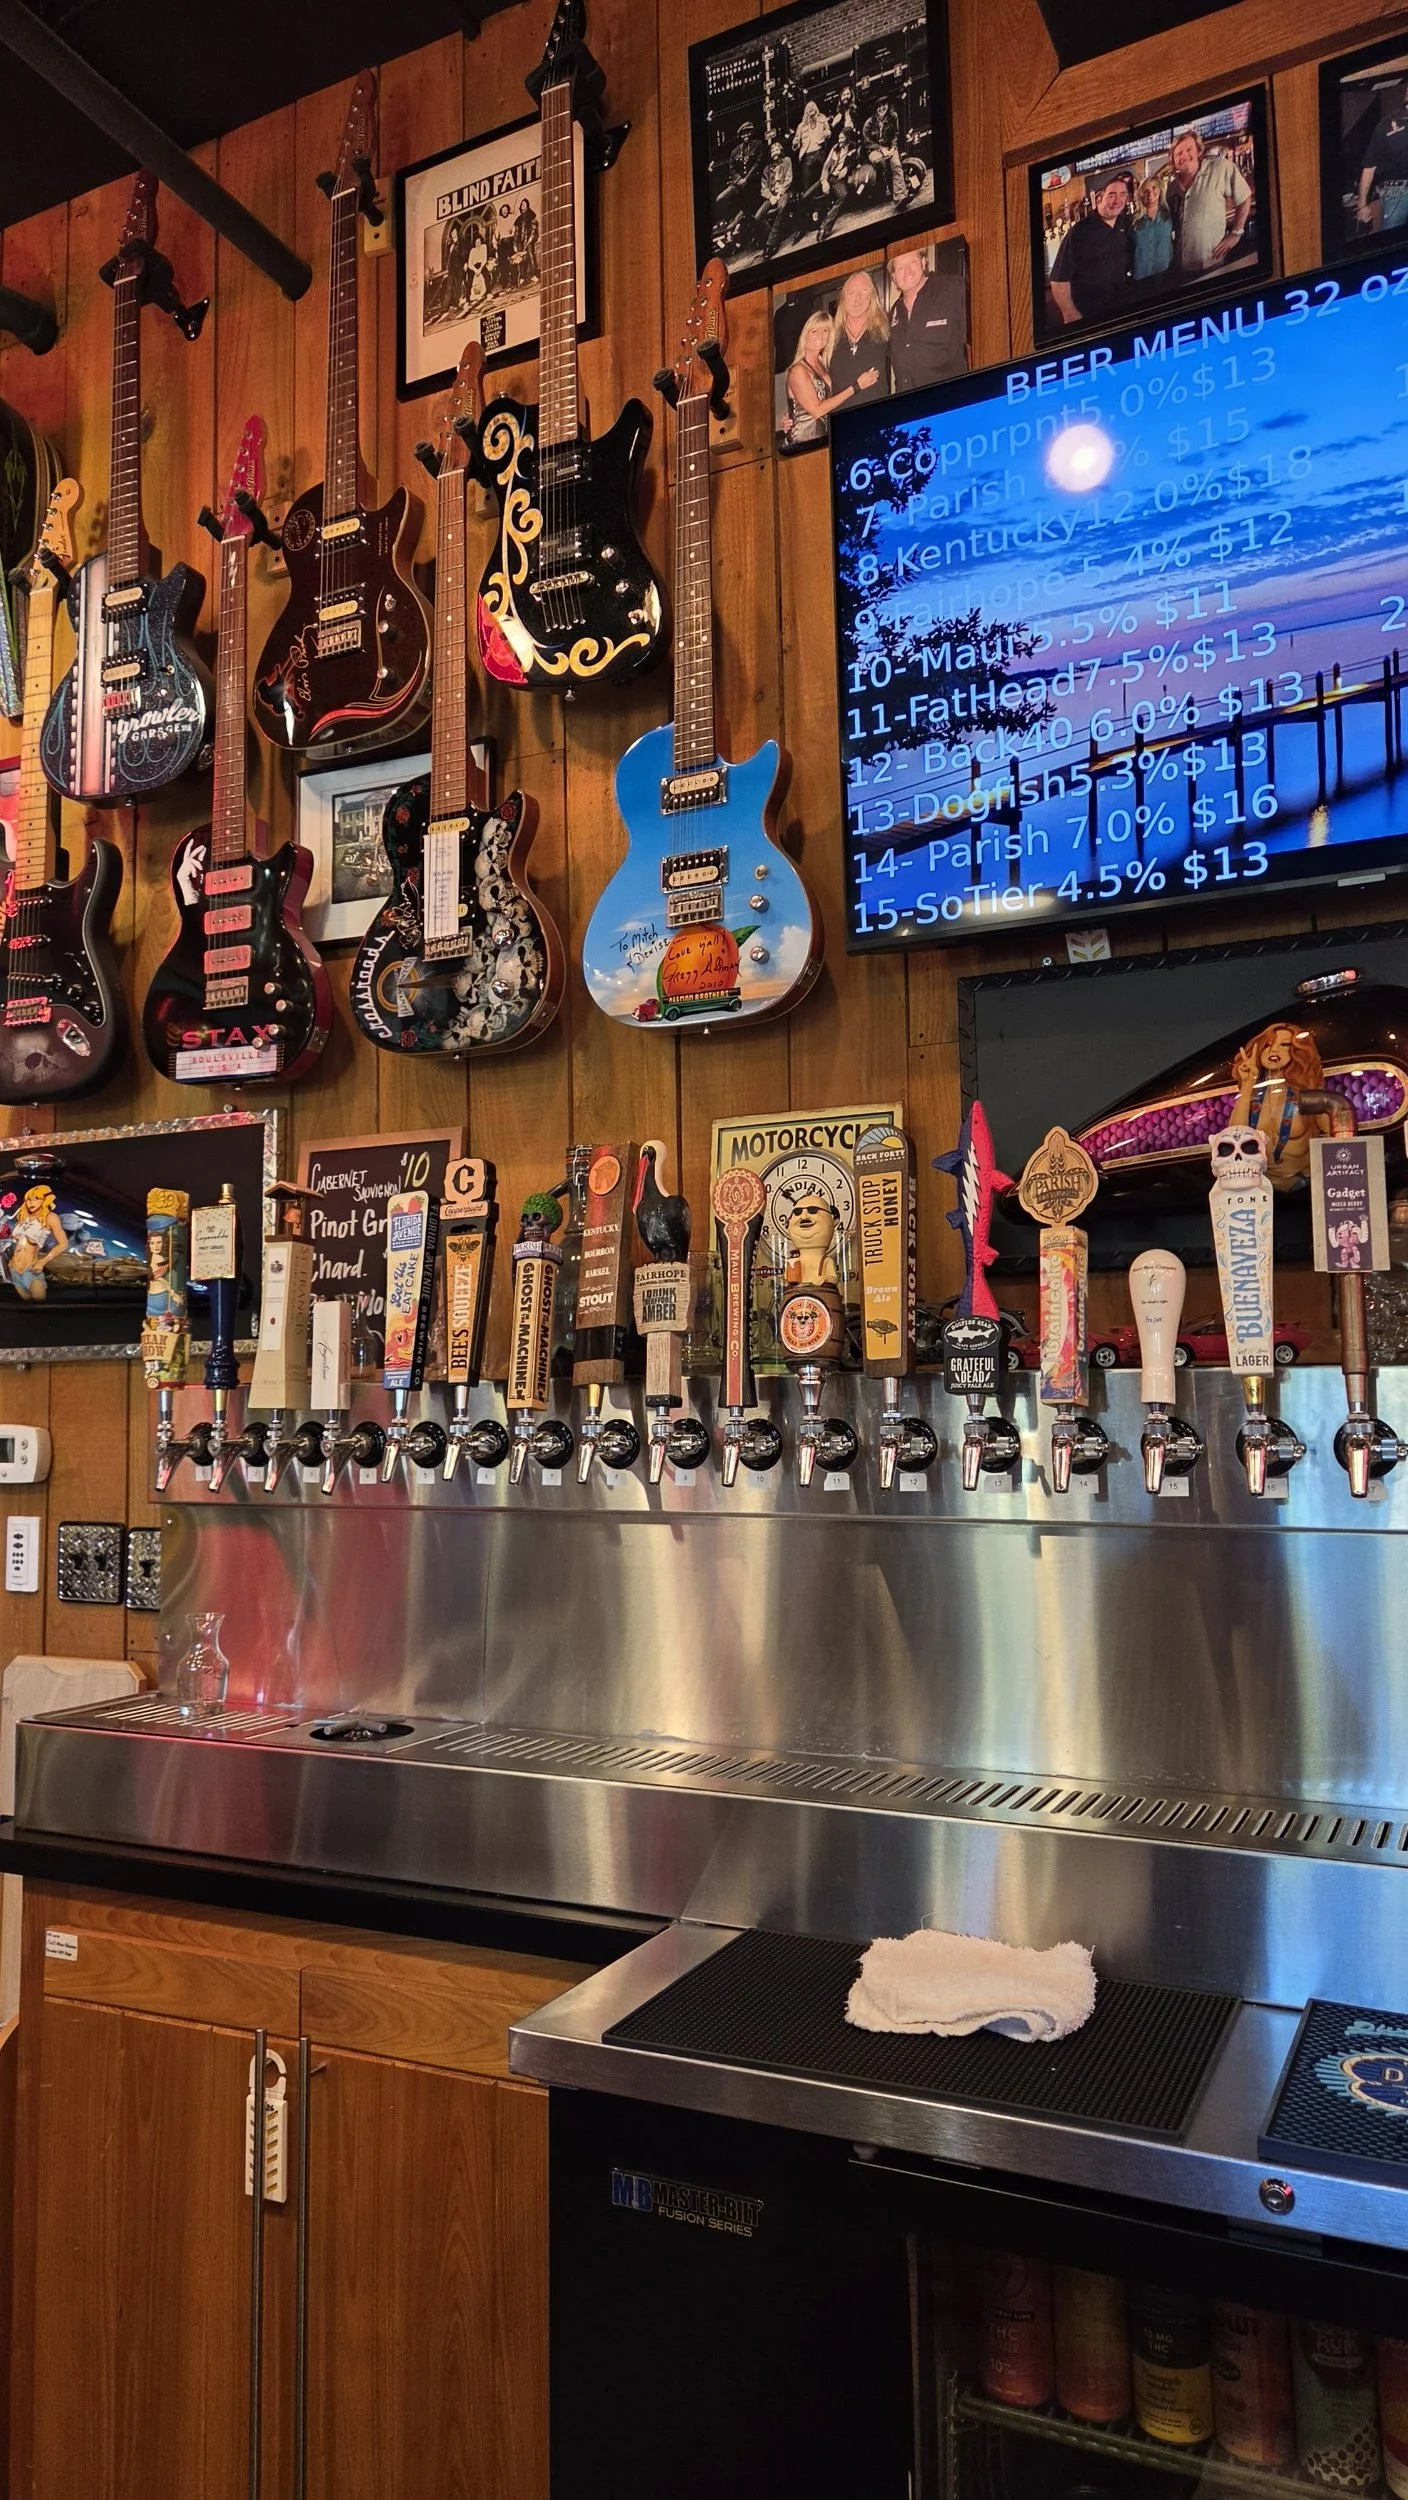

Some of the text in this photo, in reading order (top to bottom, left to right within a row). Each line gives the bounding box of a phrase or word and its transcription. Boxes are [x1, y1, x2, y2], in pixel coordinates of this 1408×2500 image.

[438, 179, 491, 218] BLIND
[1006, 347, 1117, 406] BEER
[1133, 301, 1265, 370] MENU
[1284, 280, 1341, 326] 32
[908, 469, 1025, 526] Parish
[1168, 407, 1250, 461] $15
[1082, 536, 1191, 589] 5.4%
[1209, 510, 1293, 563] $12
[848, 579, 1238, 693] 10- Maui 5.5% $11
[117, 697, 200, 743] growler
[849, 671, 1304, 788] 12- Back40 6.0% $13
[853, 783, 1278, 884] 14- Parish 7.0% $16
[854, 841, 1269, 934] 15-SoTier 4.5% $13
[610, 922, 659, 953] To Mitch
[181, 1024, 274, 1049] STAX
[191, 1051, 263, 1064] SOULSVILLE
[797, 1159, 808, 1170] 12
[855, 1149, 906, 1162] BACK FORTY
[310, 1151, 431, 1193] CABERNET $10
[451, 1164, 476, 1195] C
[776, 1166, 785, 1177] 11
[836, 1179, 843, 1189] 2
[1035, 1174, 1081, 1193] PARISH
[1326, 1169, 1365, 1177] ARTIFACT
[353, 1175, 402, 1204] SAUVIGNON
[781, 1181, 825, 1200] INDIAN
[882, 1178, 899, 1228] HONEY
[1327, 1187, 1366, 1200] Gadget
[844, 1200, 850, 1211] 3
[310, 1209, 358, 1240] Pinot
[392, 1224, 421, 1241] AVENUE
[393, 1215, 421, 1231] FLORIDA
[424, 1204, 439, 1250] FLORIDA
[583, 1223, 620, 1238] KENTUCKY
[762, 1225, 770, 1236] 8
[862, 1179, 884, 1267] TRUCK STOP
[584, 1246, 615, 1259] BOURBON
[731, 1249, 740, 1278] MAUI
[907, 1176, 917, 1345] BACK FORTY
[401, 1252, 419, 1316] EAT CAKE
[422, 1251, 435, 1300] AVENUE
[584, 1266, 611, 1279] BARREL
[636, 1269, 687, 1282] FAIRHOPE
[1228, 1208, 1265, 1344] BUENAVEZA
[519, 1262, 535, 1313] GHOST
[578, 1291, 614, 1308] STOUT
[866, 1285, 898, 1295] Brown
[873, 1294, 891, 1304] Ale
[450, 1263, 473, 1370] BEE'S SQUEEZE
[642, 1303, 677, 1324] AMBER
[730, 1283, 740, 1337] BREWING
[416, 1306, 428, 1363] BREWING
[536, 1264, 554, 1392] GHOST MACHINE
[951, 1319, 992, 1331] DOGFISH HEAD
[514, 1324, 532, 1390] MACHINE
[950, 1357, 995, 1372] GRATEFUL
[1235, 1355, 1269, 1367] LAGER
[390, 1377, 404, 1388] ALE
[960, 1370, 985, 1383] DEAD
[1079, 1479, 1089, 1488] 14
[1169, 1482, 1179, 1490] 15
[652, 2180, 760, 2228] MASTER-BILT
[658, 2206, 753, 2237] FUSION SERIES
[1149, 2342, 1169, 2354] THC
